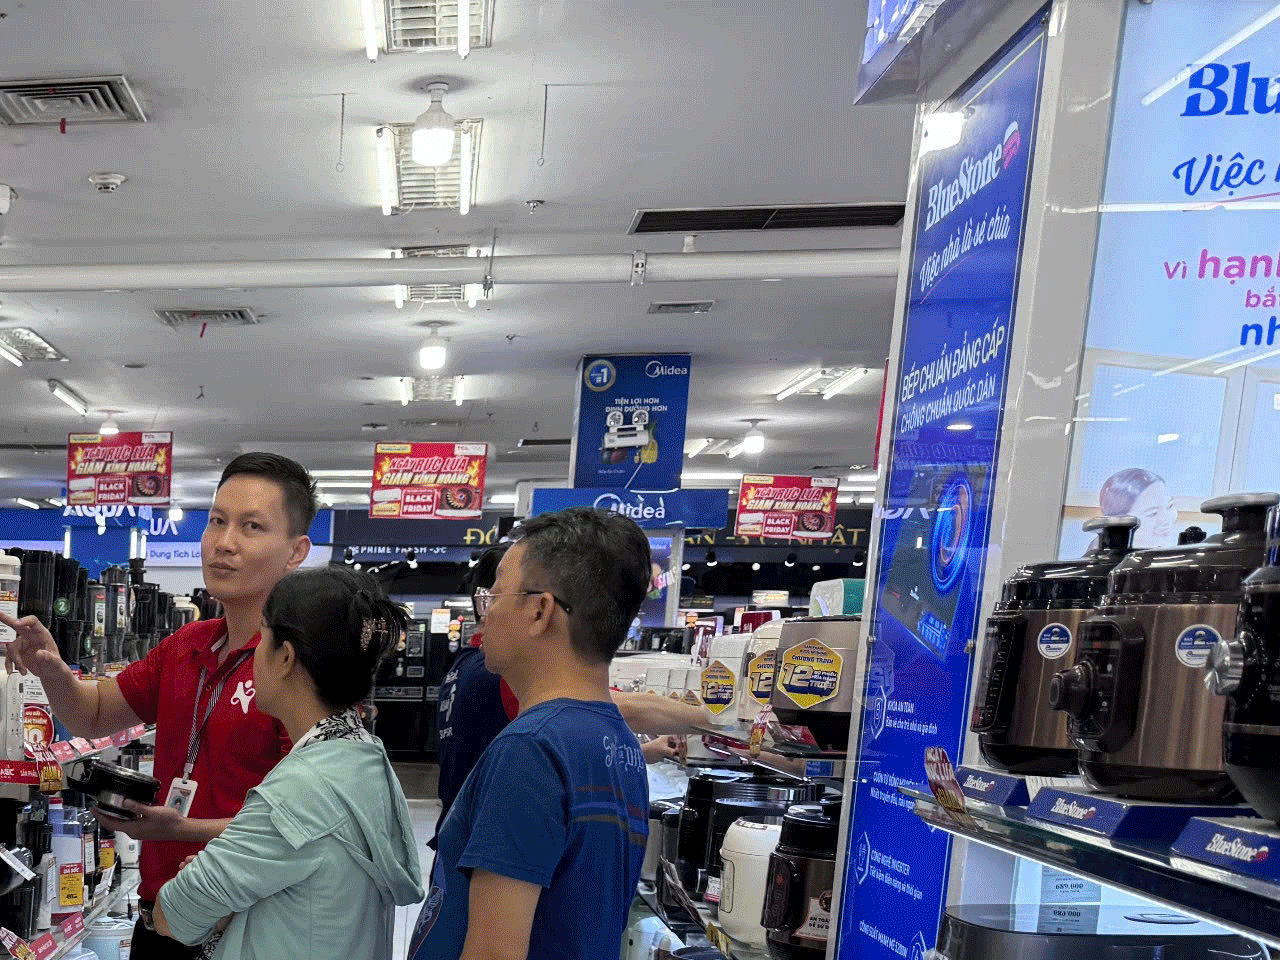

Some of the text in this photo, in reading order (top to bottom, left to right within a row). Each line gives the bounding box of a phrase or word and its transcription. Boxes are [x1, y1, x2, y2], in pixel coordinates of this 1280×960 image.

[1172, 152, 1266, 195] Việc
[925, 143, 1002, 231] BlueStone
[987, 204, 1011, 241] chia
[1164, 248, 1280, 288] vì hạn
[649, 362, 688, 377] Midea
[901, 361, 919, 402] BẾP
[919, 343, 952, 393] CHUẨN
[981, 316, 1004, 364] CẤP
[953, 377, 976, 412] QUỐC
[976, 371, 996, 402] DÂN
[76, 461, 103, 475] GIẢM
[98, 493, 125, 501] FRIDAY
[99, 483, 125, 491] BLACK
[404, 505, 433, 513] FRIDAY
[604, 497, 666, 518] Midea
[361, 546, 392, 554] PRIME
[782, 663, 813, 687] 12
[702, 681, 719, 699] 12
[963, 775, 990, 791] BlueStone
[1051, 797, 1089, 820] BlueStone
[1205, 833, 1258, 861] BlueStone
[1055, 882, 1084, 890] 689.000
